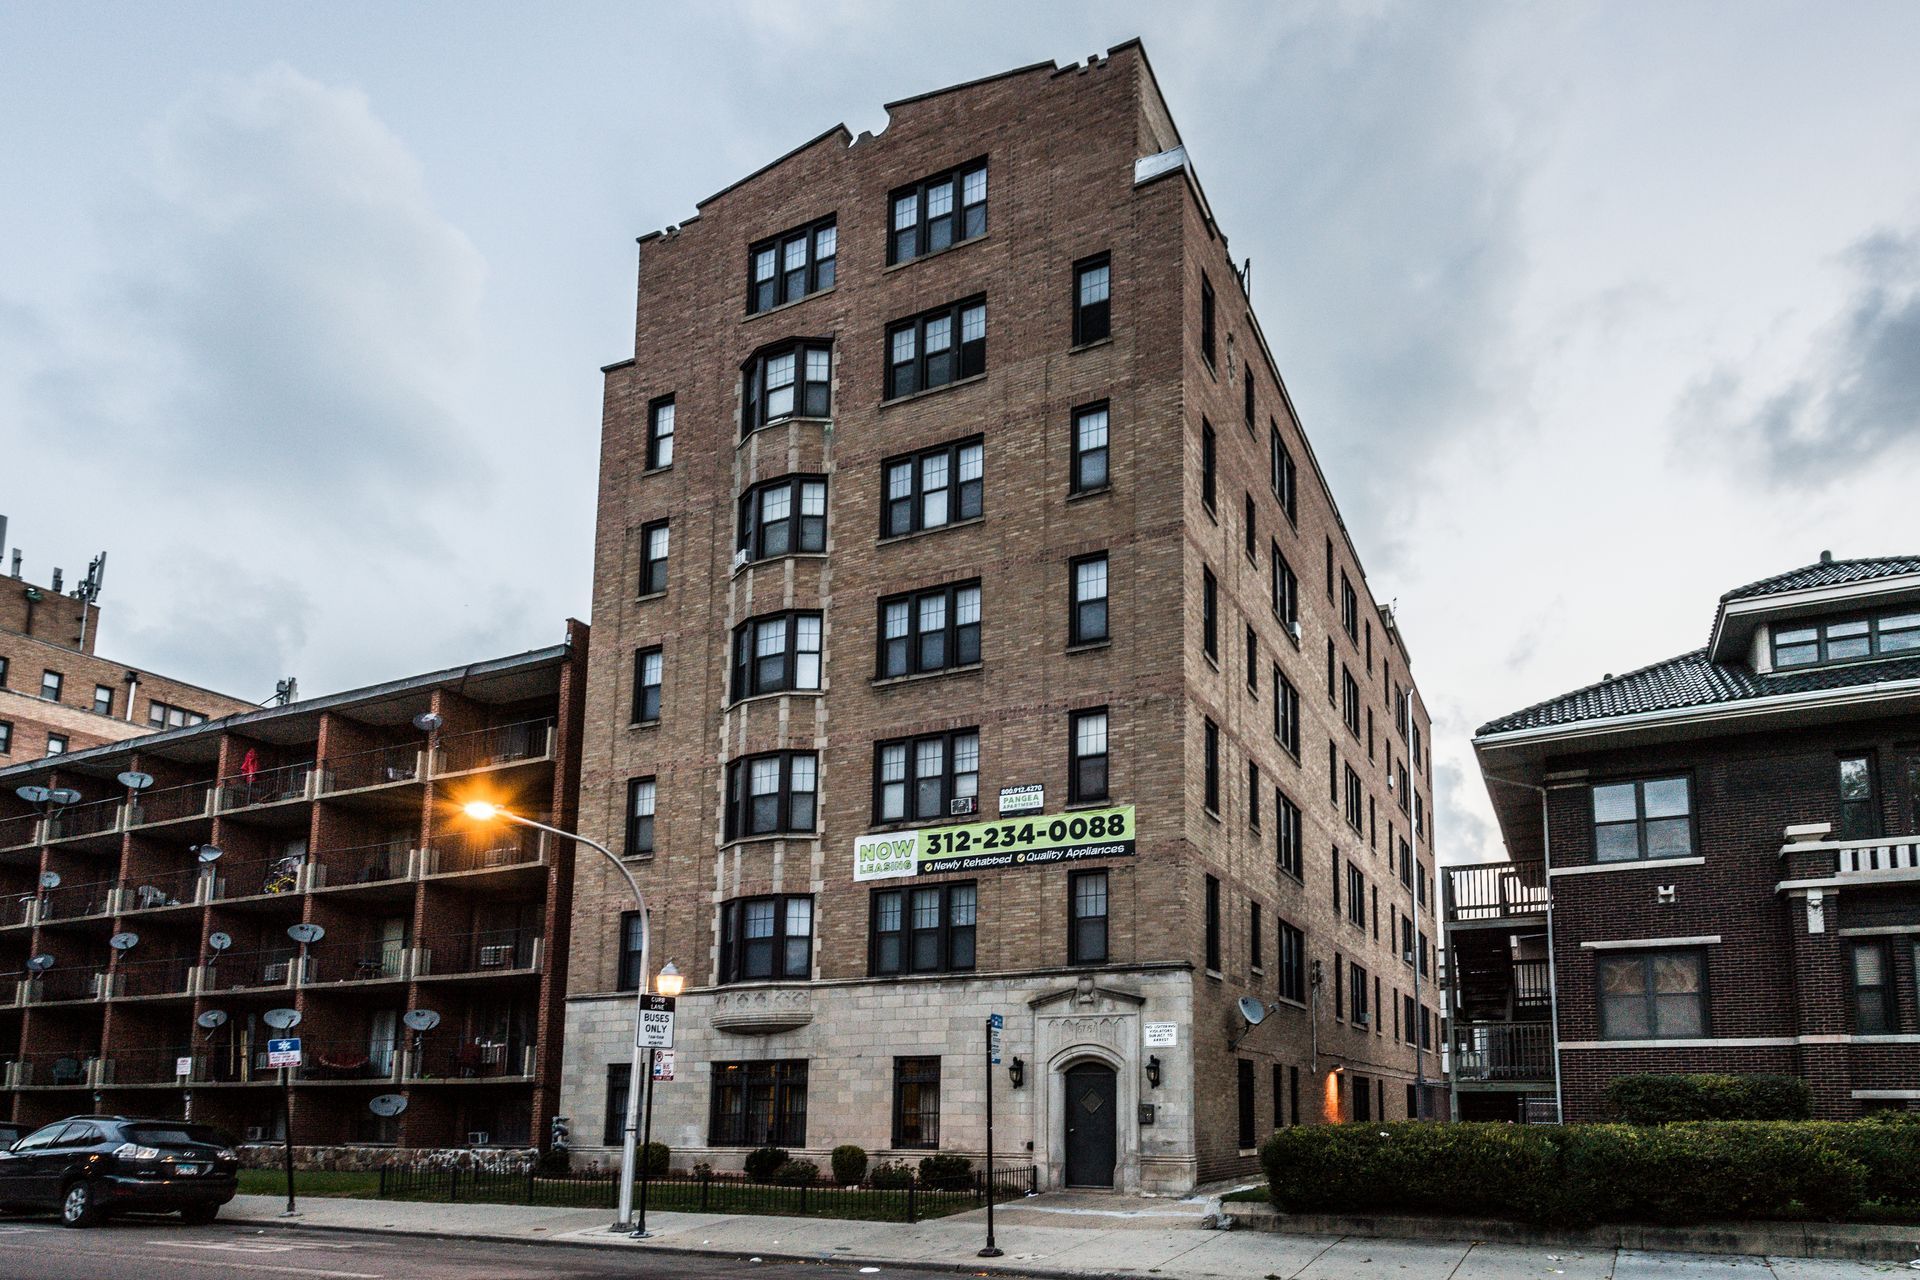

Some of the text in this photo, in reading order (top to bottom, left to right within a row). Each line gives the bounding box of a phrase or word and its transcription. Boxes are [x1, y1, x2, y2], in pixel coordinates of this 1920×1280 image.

[1002, 801, 1040, 809] APARTMENTS
[1003, 794, 1039, 804] PANGEA
[926, 814, 1125, 855] 312-234-0088
[860, 838, 915, 862] NOW
[1026, 844, 1125, 862] Quality Appliances
[860, 860, 912, 875] LEASING
[933, 854, 1013, 871] Newly Rehabbed
[651, 996, 666, 1004] CURB
[644, 1013, 670, 1023] BUSES
[645, 1024, 668, 1033] ONLY
